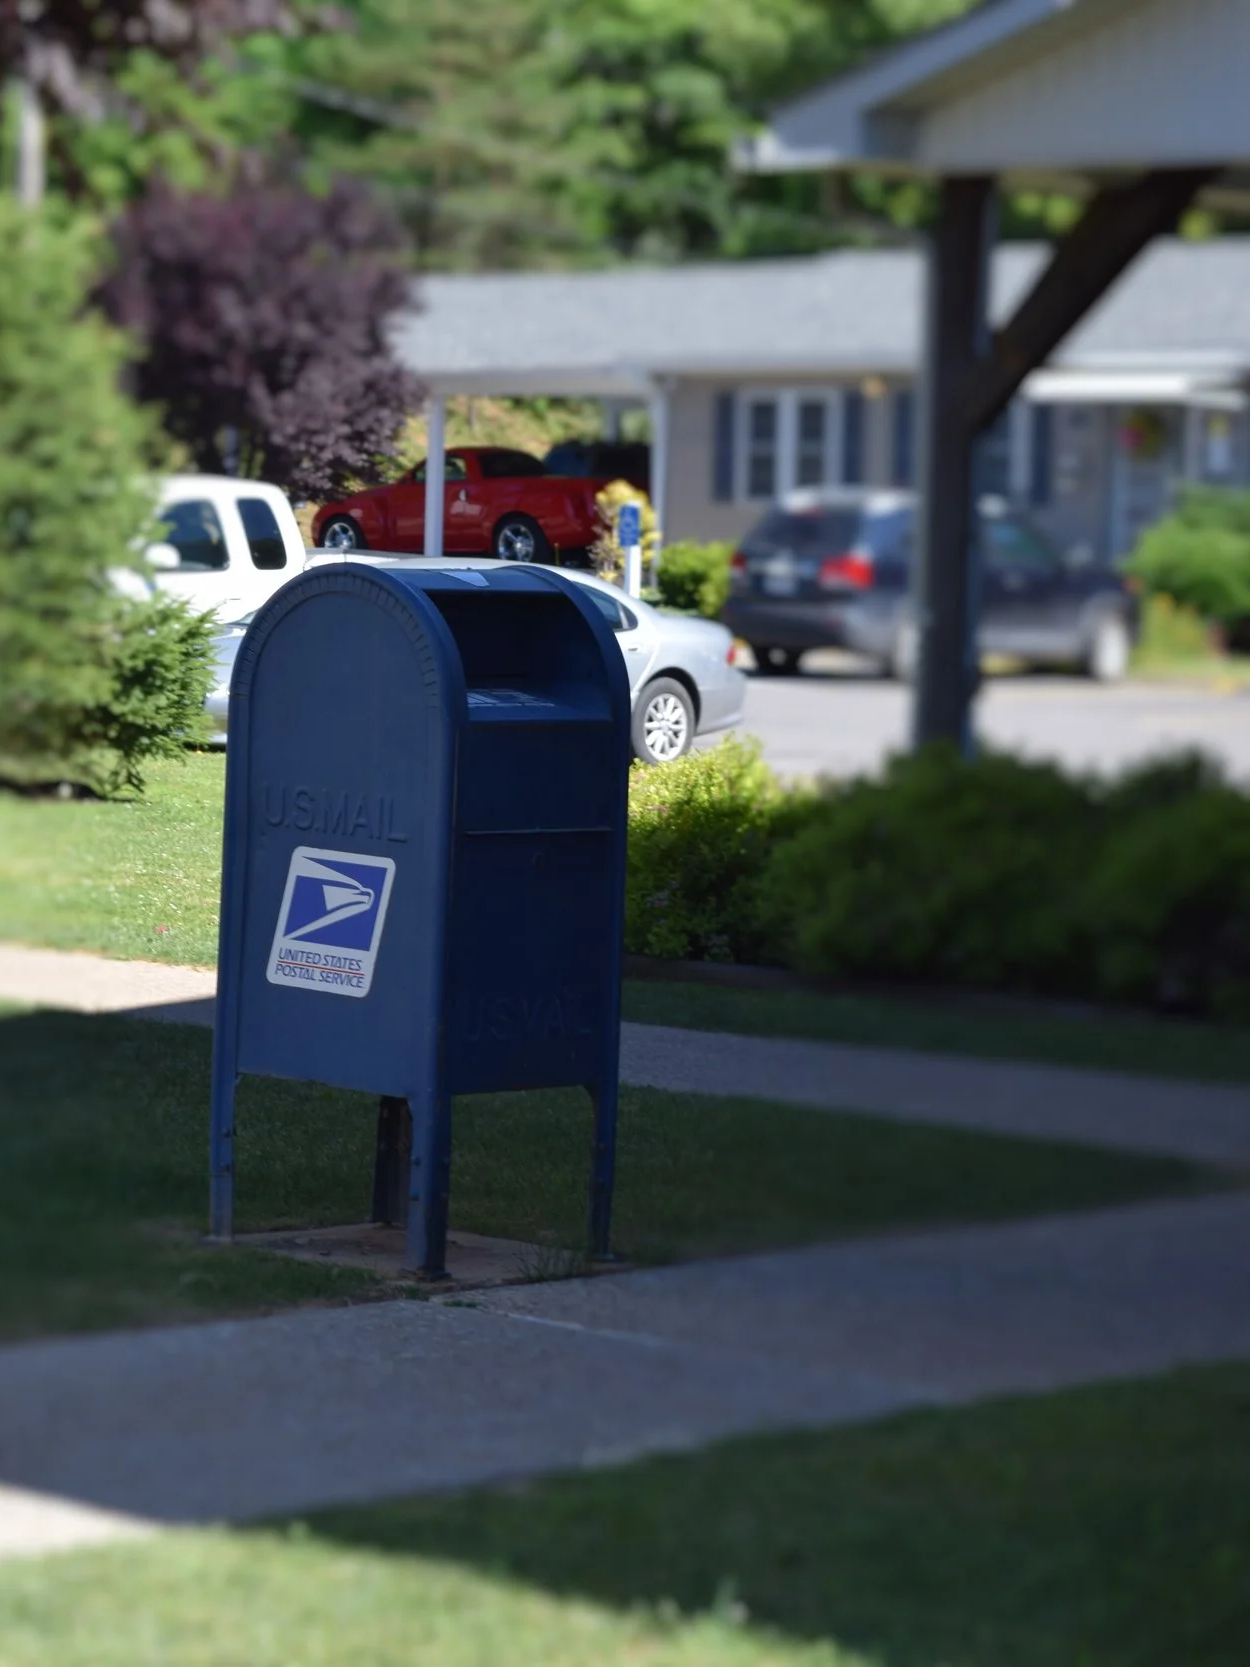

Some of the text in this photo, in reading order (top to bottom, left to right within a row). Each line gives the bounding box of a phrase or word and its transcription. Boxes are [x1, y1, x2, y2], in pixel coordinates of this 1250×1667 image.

[278, 947, 363, 972] UNITED STATES
[274, 963, 366, 989] POSTAL SERVICE
